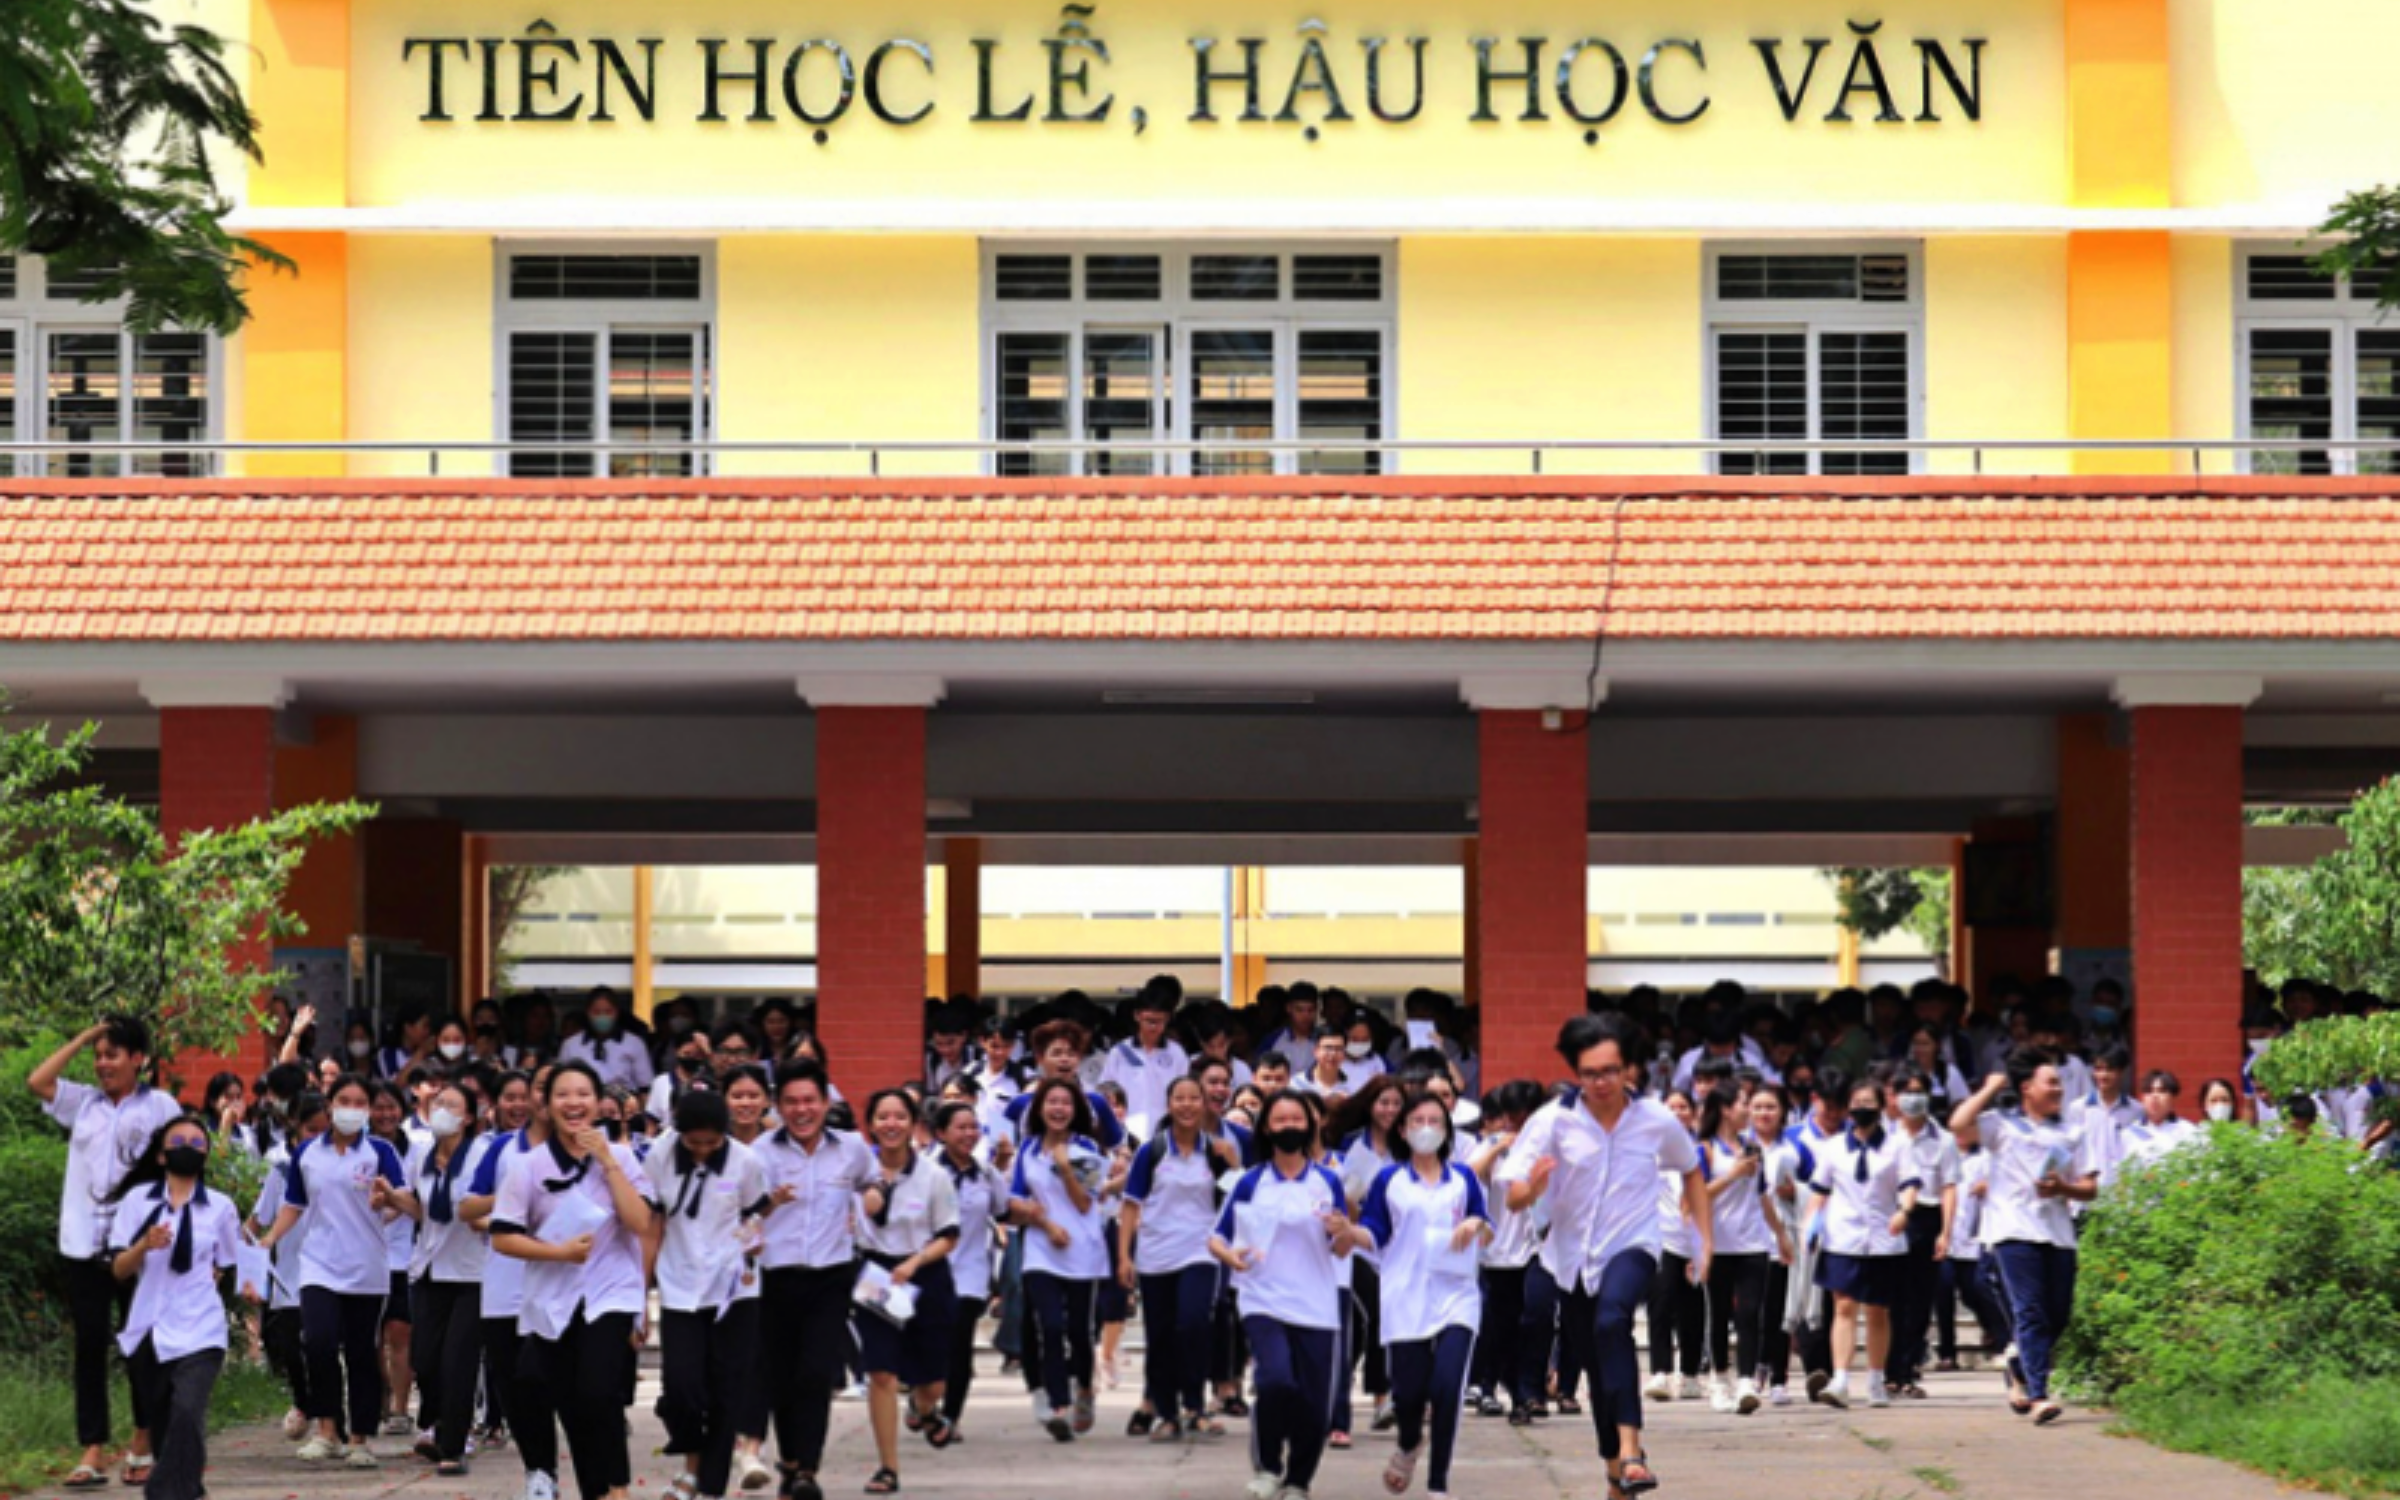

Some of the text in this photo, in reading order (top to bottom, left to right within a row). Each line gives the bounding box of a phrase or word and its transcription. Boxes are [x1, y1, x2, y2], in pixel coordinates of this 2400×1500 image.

[695, 37, 934, 145] HỌC
[969, 3, 1148, 136] LỄ,
[1188, 18, 1428, 141] HẬU
[1469, 37, 1711, 146] HỌC
[1750, 19, 1987, 122] VĂN
